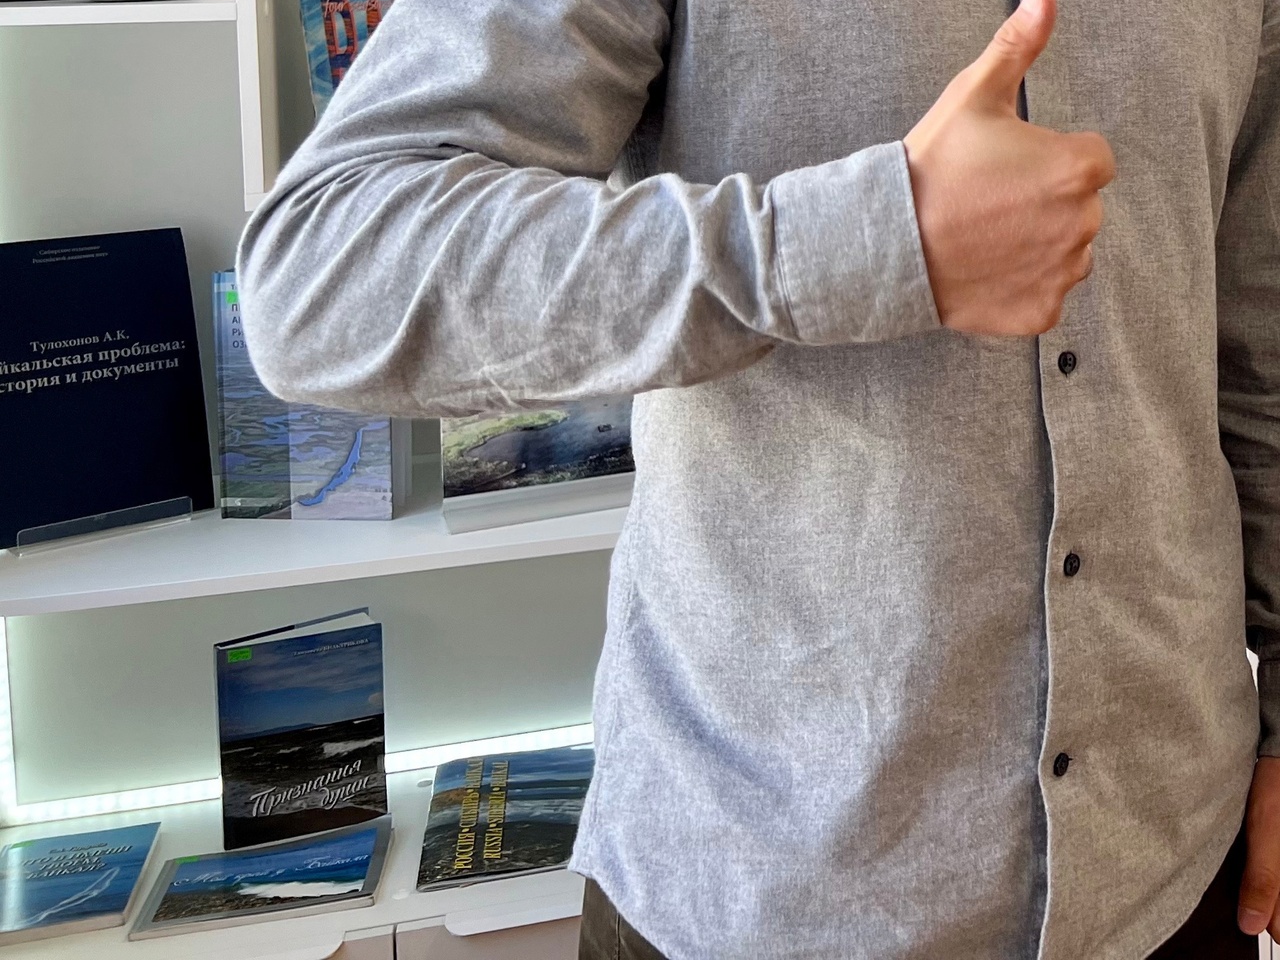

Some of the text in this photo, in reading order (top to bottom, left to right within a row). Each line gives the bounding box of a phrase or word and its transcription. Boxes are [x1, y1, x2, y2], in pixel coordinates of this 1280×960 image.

[30, 329, 130, 354] Тулохонов А.К.
[98, 340, 186, 362] проблема:
[65, 372, 78, 384] и
[82, 357, 180, 382] документы
[250, 759, 362, 816] Признания
[320, 776, 370, 810] души
